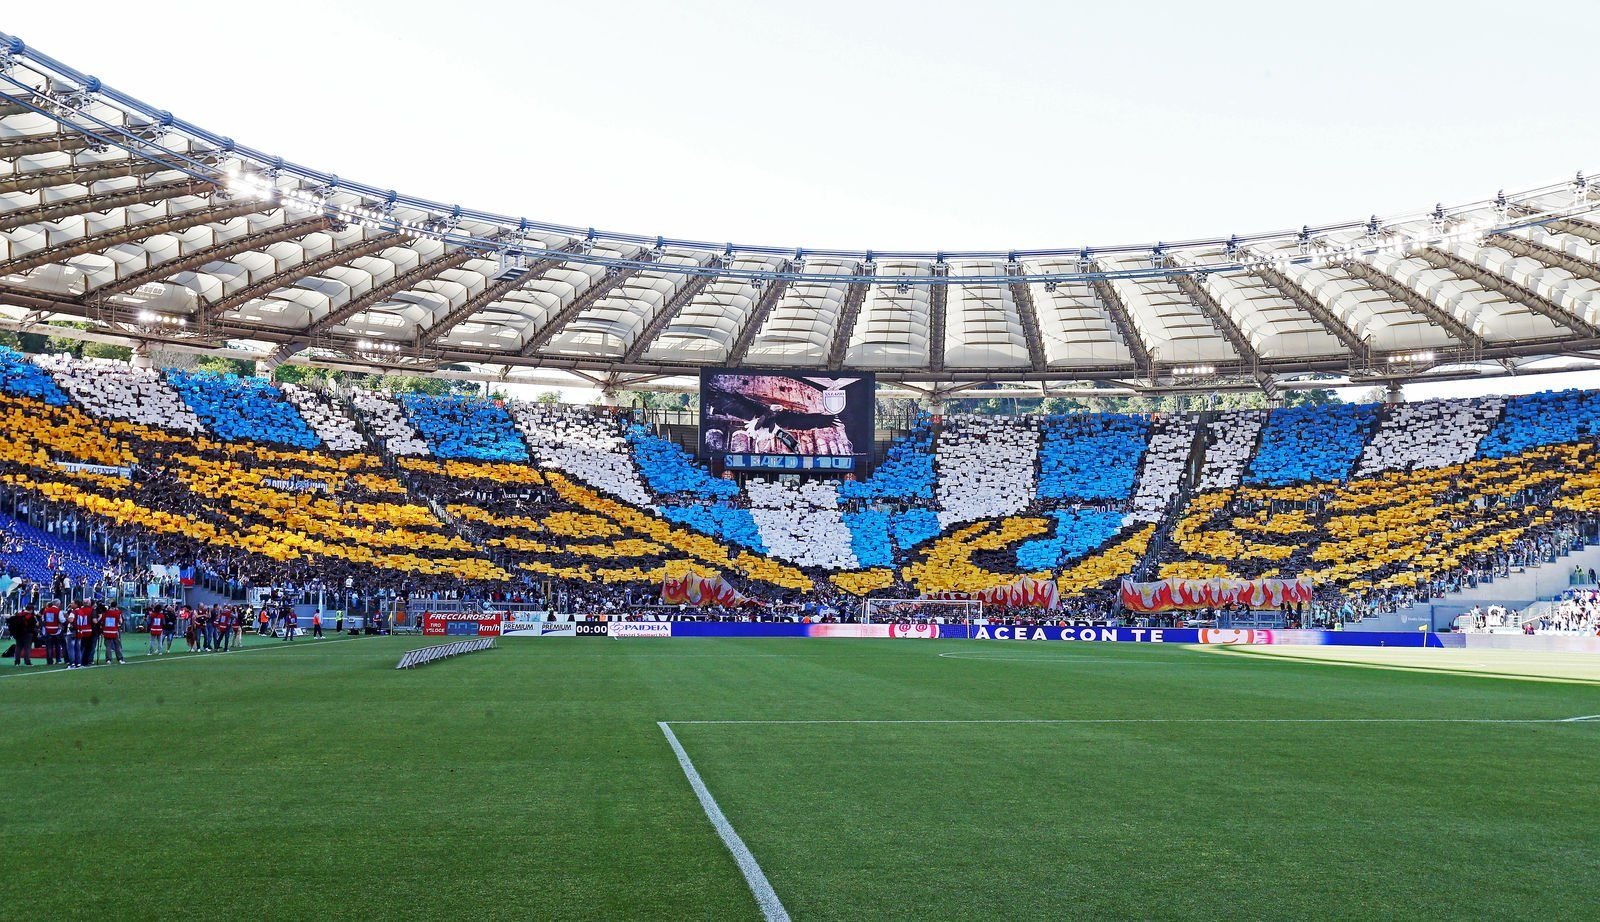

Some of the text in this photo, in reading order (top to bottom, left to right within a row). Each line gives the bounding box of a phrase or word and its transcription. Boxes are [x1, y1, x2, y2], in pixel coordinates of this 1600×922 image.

[429, 613, 496, 621] FRECCIAROSSA
[479, 623, 500, 632] km/h
[576, 625, 608, 634] 00:00
[975, 627, 1164, 643] ACEA CON TE
